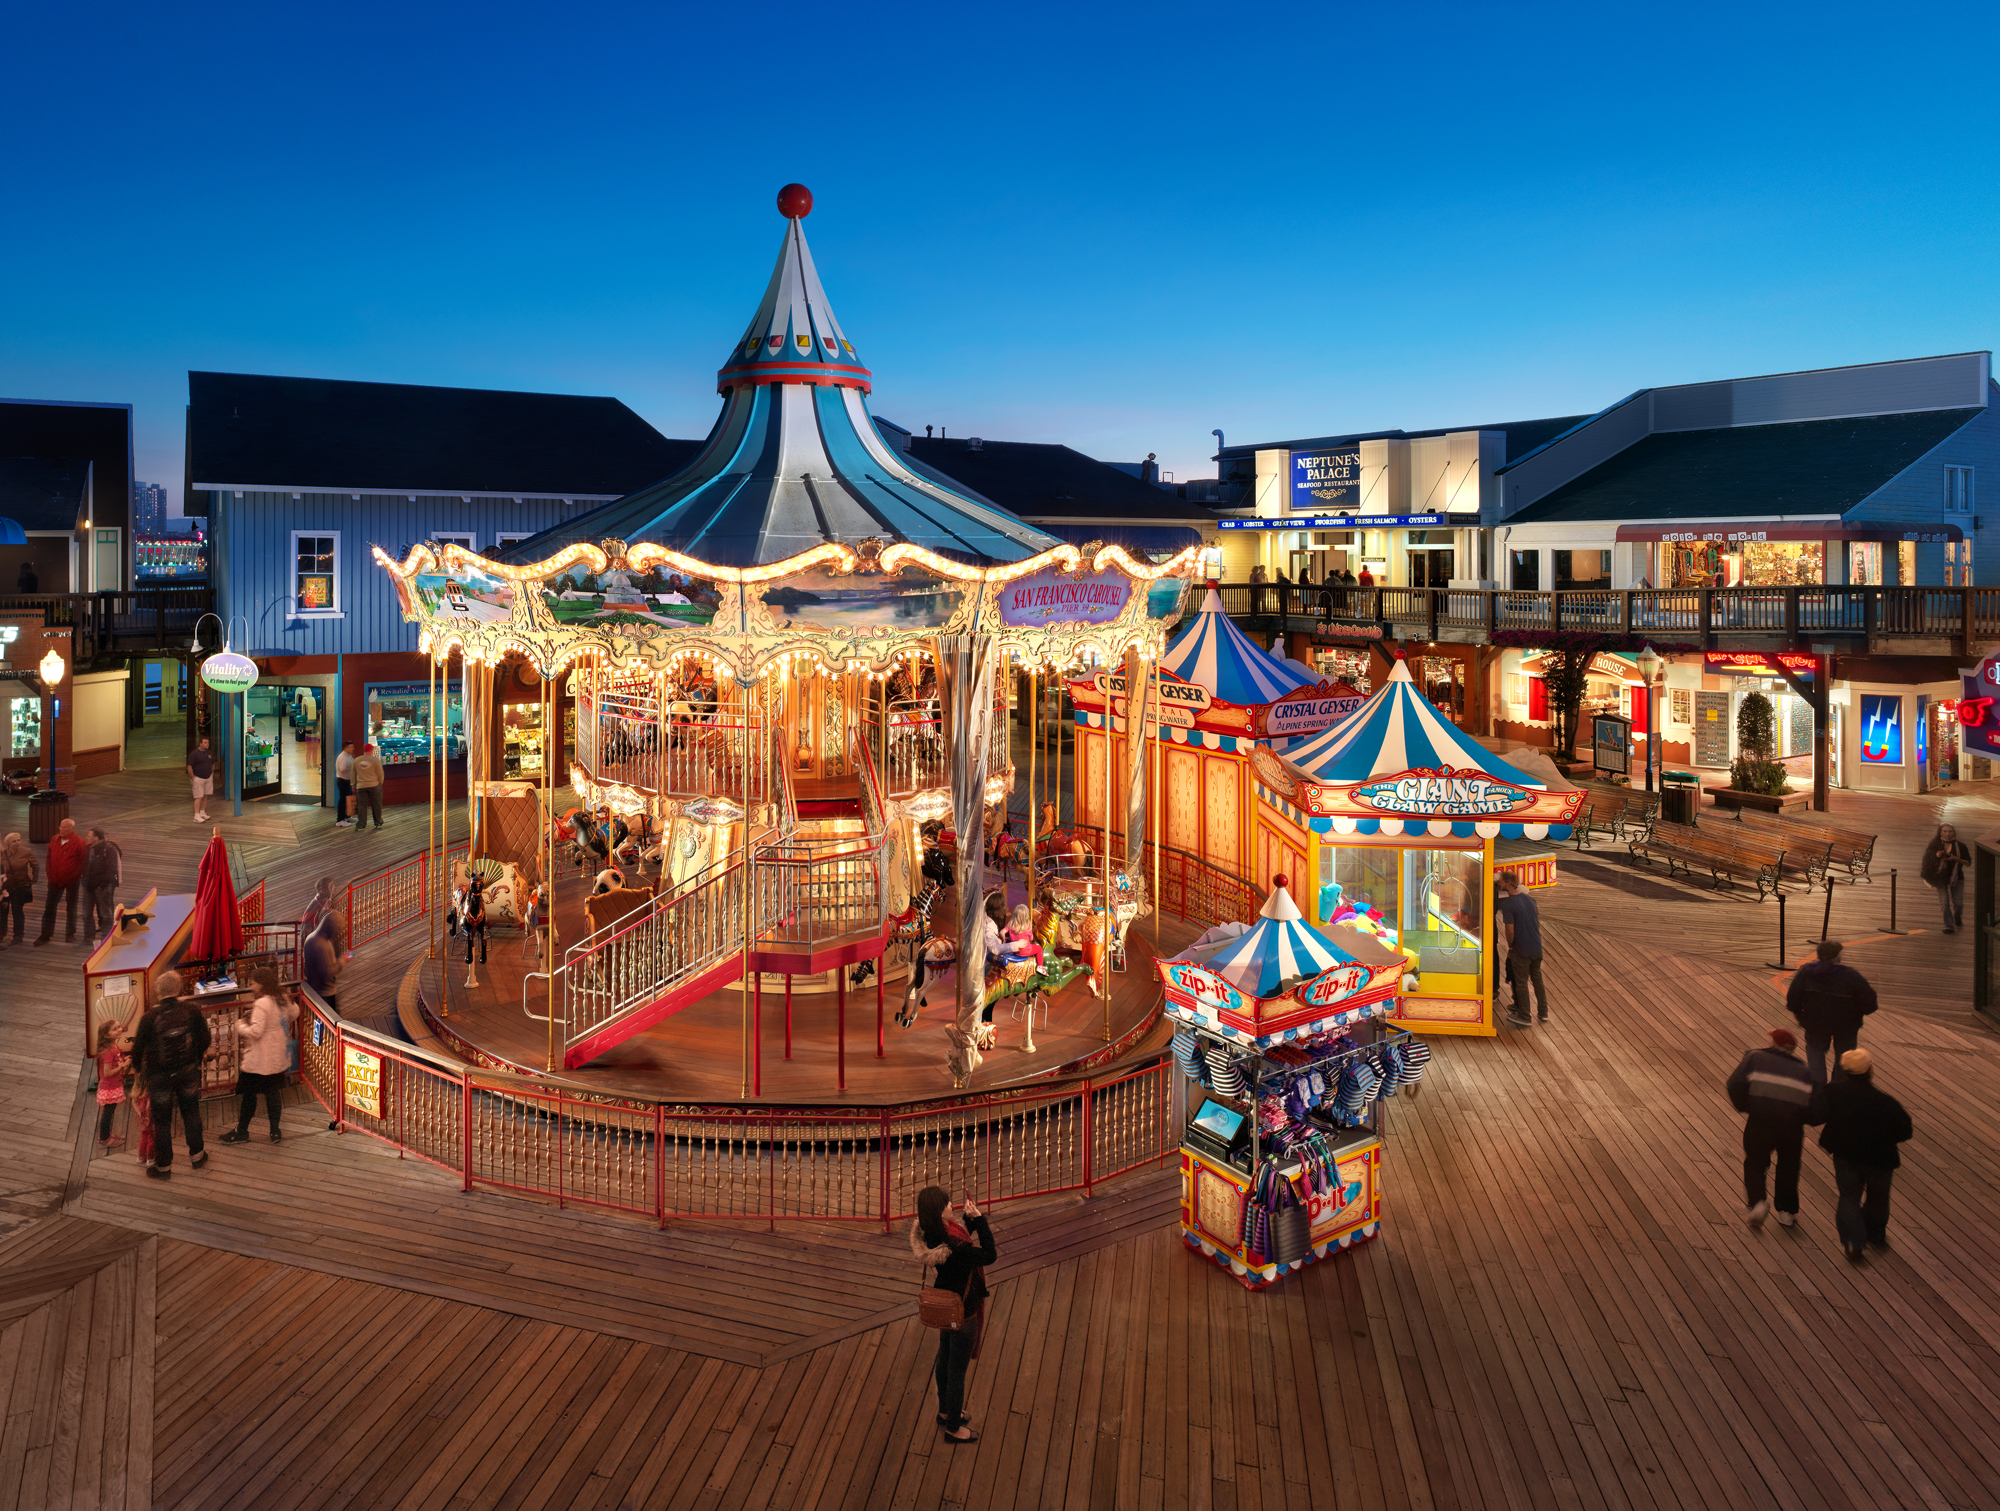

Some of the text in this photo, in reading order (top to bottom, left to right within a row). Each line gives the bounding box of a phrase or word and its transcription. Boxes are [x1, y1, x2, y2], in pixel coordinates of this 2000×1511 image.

[1297, 453, 1360, 469] NEPTUNE'S
[1307, 467, 1350, 480] PALACE
[1297, 479, 1360, 489] SEAFOOD RESTAURANT
[1408, 516, 1437, 524] OYSTERS
[1011, 583, 1122, 610] SAN FRANCISCO CAROUSEL
[1061, 604, 1079, 612] PIER
[1081, 603, 1090, 611] 39
[1328, 622, 1383, 639] UNDERGROUND
[204, 662, 242, 679] Vitality
[1596, 657, 1626, 676] HOUSE
[380, 687, 410, 695] Revitalize
[1160, 684, 1205, 703] GEYSER
[1274, 698, 1360, 719] CRYSTAL GEYSER
[1166, 715, 1189, 726] WATER
[1274, 720, 1302, 731] ALPINE
[1302, 718, 1328, 730] SPRING
[1373, 777, 1513, 802] THE GIANT FAMOUS
[1371, 795, 1514, 815] CLAW GAME
[345, 1063, 379, 1083] EXIT
[344, 1080, 380, 1100] ONLY
